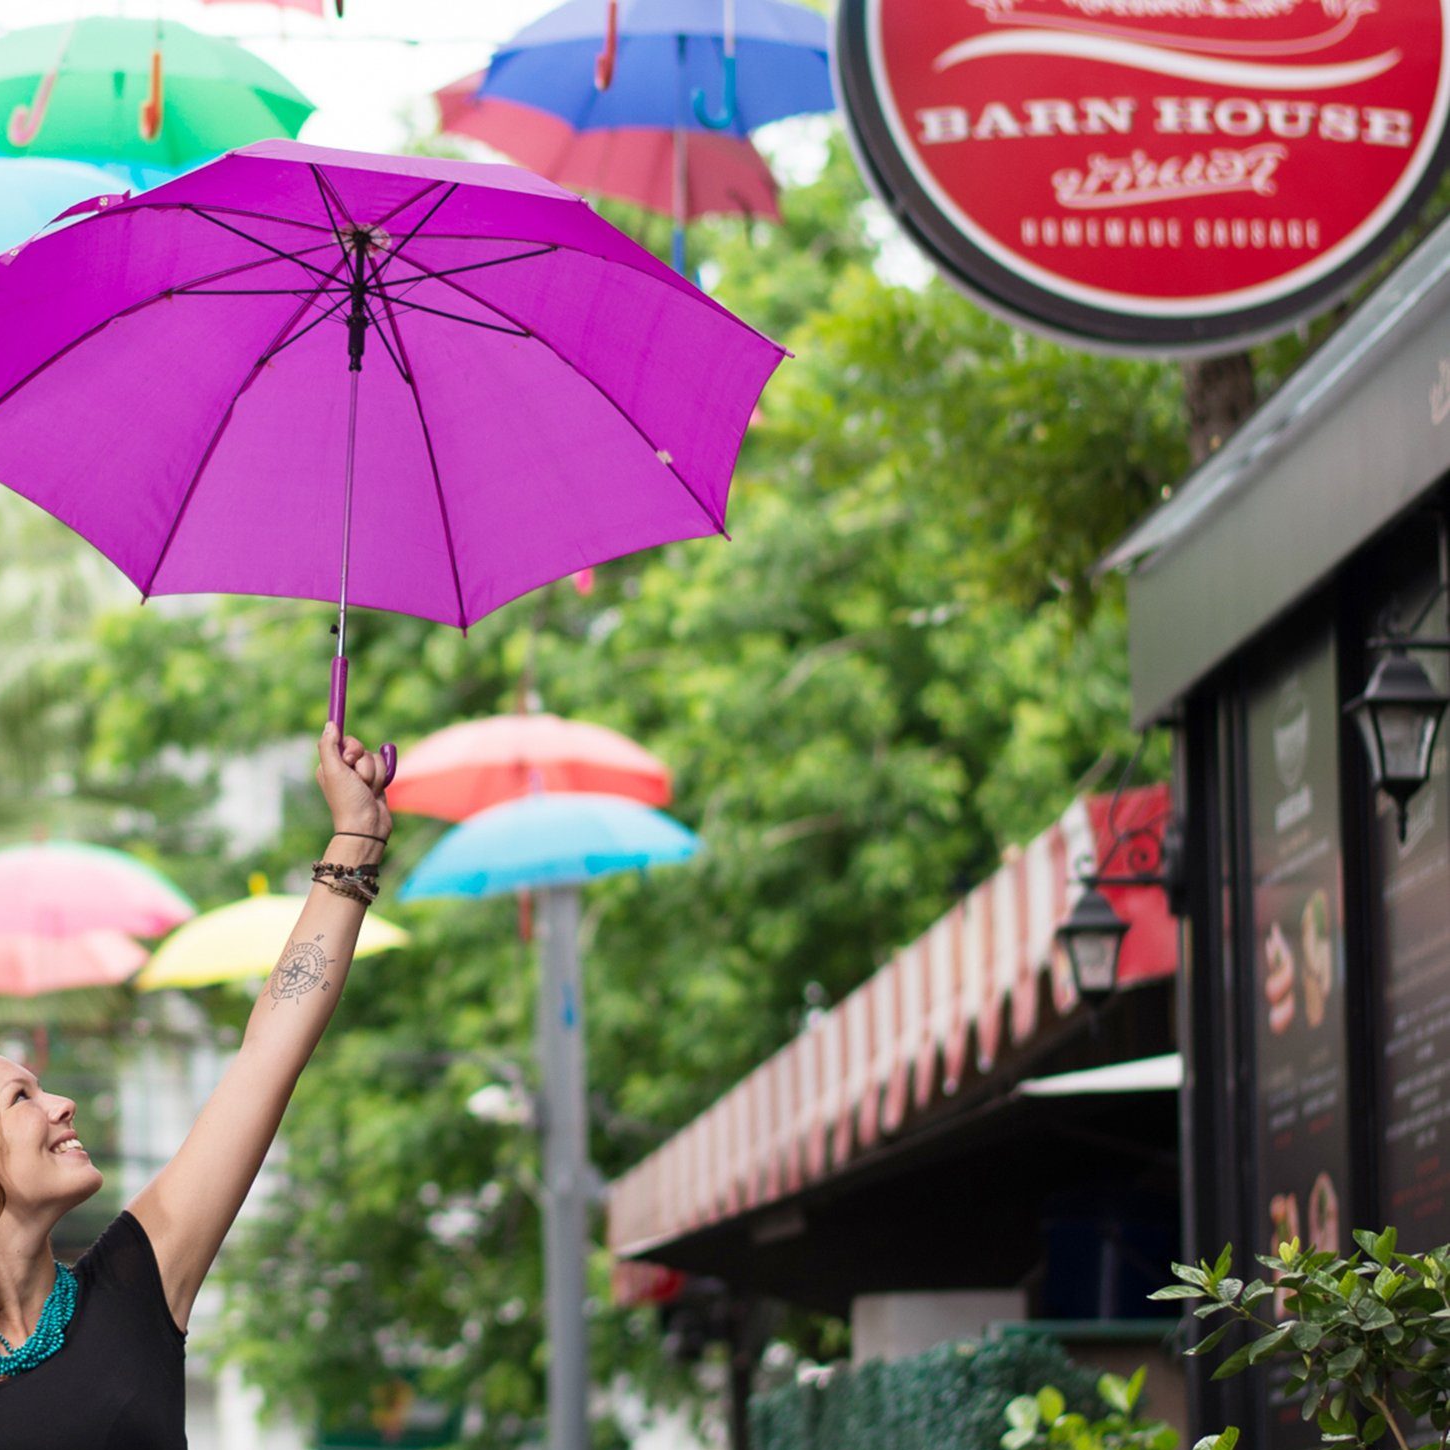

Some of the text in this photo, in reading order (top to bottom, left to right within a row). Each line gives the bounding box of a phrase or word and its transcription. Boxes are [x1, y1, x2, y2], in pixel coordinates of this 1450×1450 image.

[916, 97, 1413, 147] BARN HOUSE
[1021, 217, 1320, 249] HOMEMADE SAUSAGE
